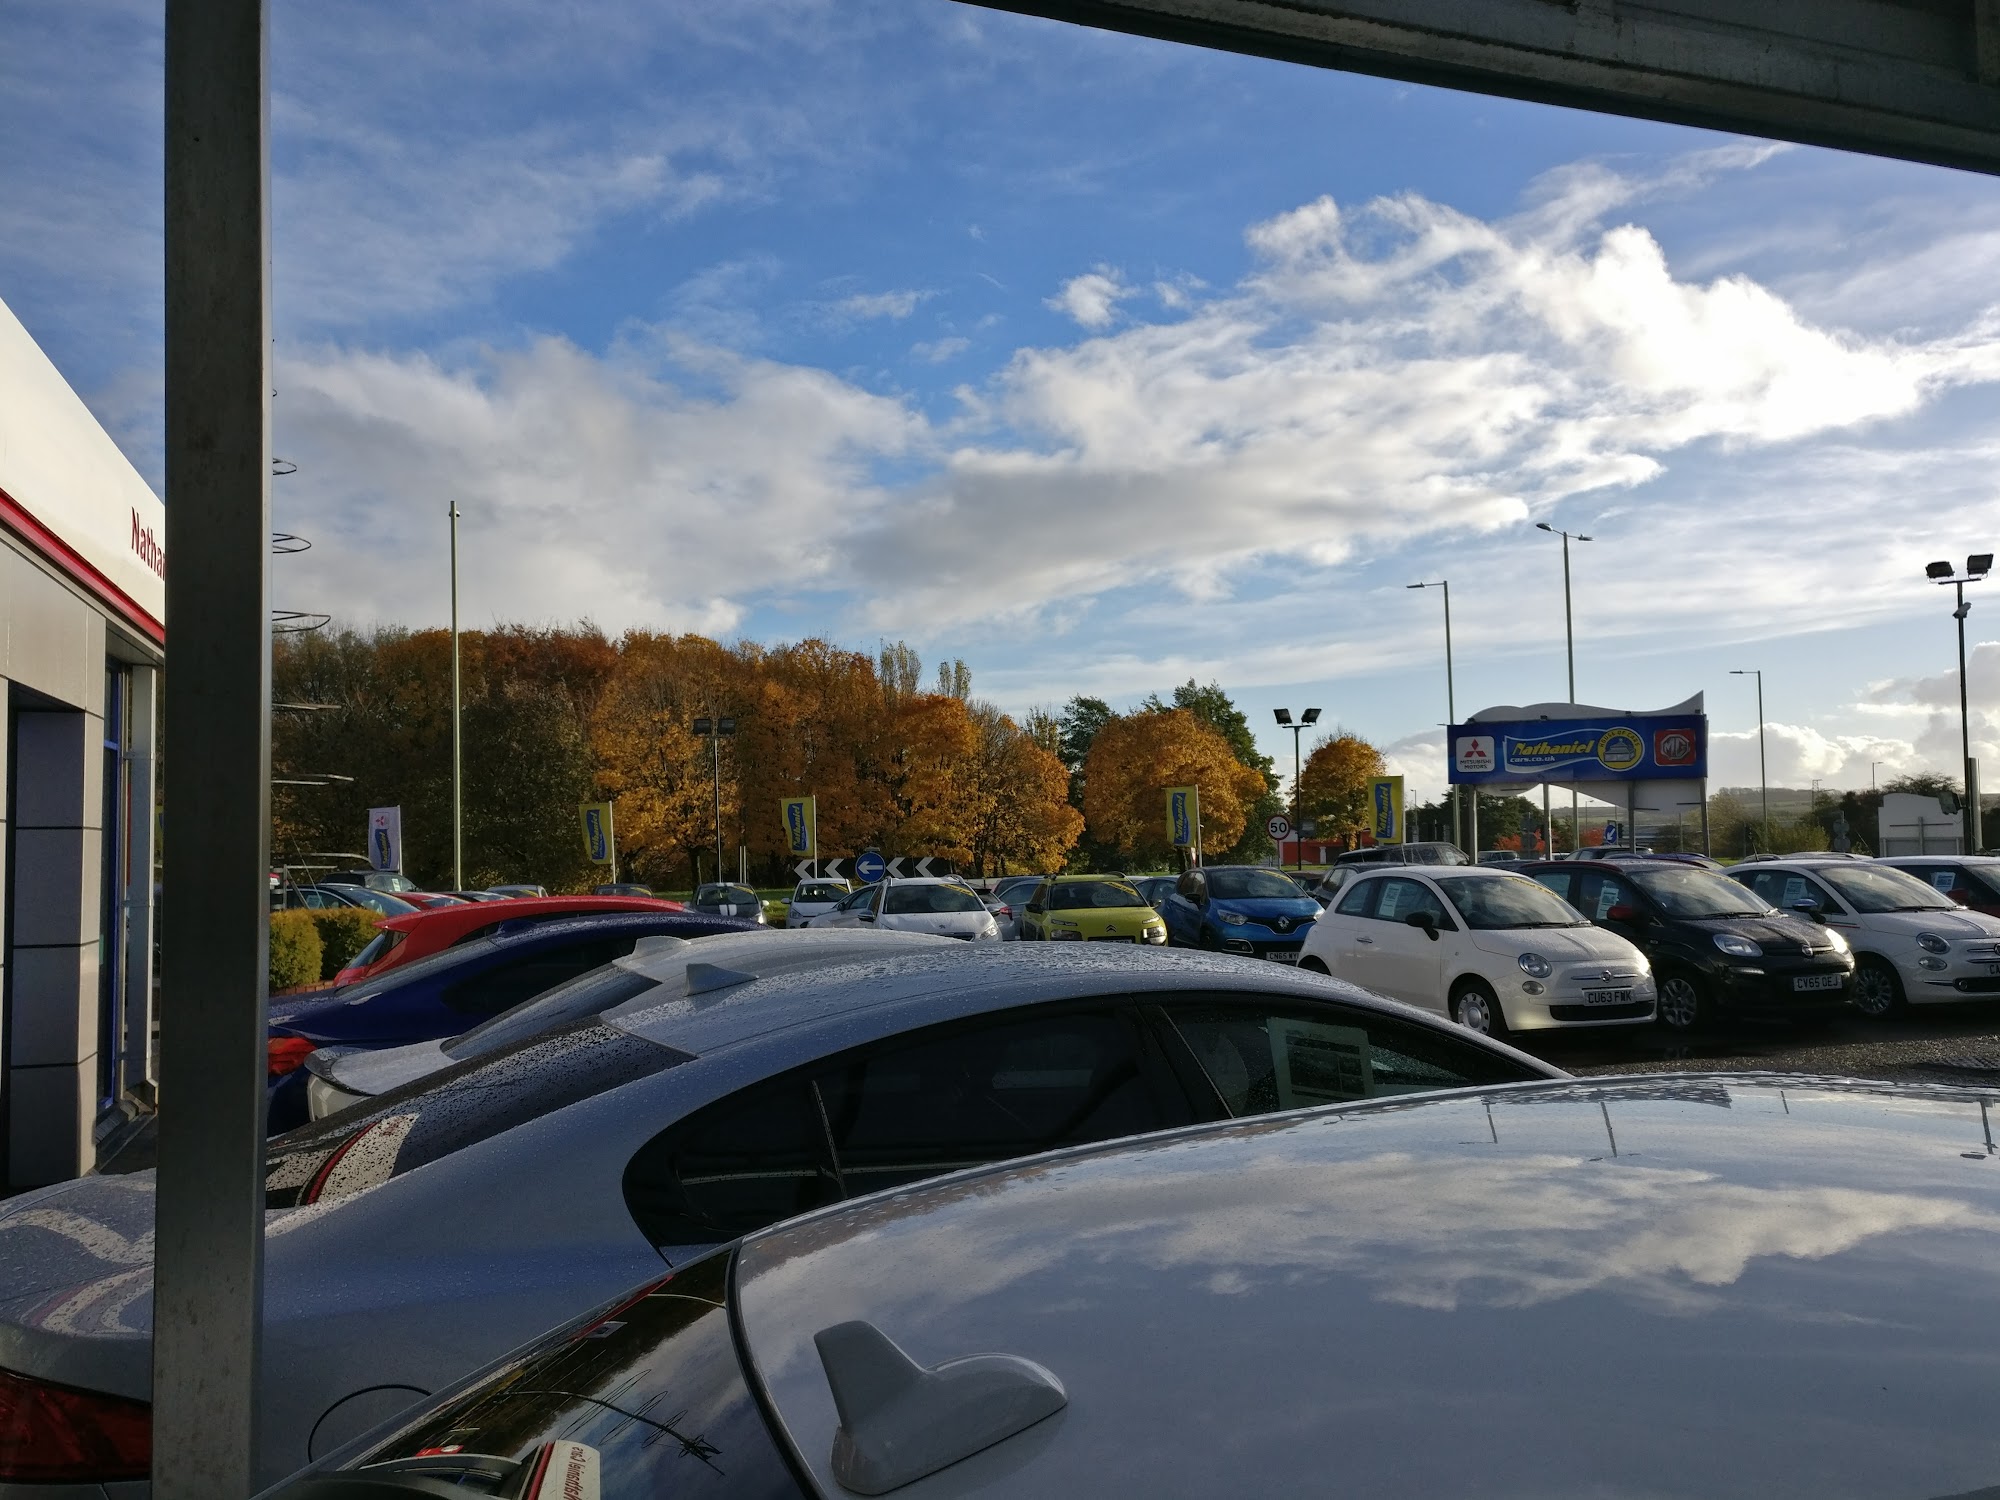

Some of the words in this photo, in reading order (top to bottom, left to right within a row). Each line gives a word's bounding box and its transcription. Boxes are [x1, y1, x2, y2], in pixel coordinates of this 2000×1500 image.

[1512, 740, 1595, 756] Nathaniel
[1662, 736, 1688, 760] MG
[1270, 822, 1287, 833] 50
[1269, 952, 1287, 960] CN65
[1797, 977, 1820, 988] CV65
[1821, 976, 1838, 987] OEJ
[1588, 992, 1612, 1004] CU63
